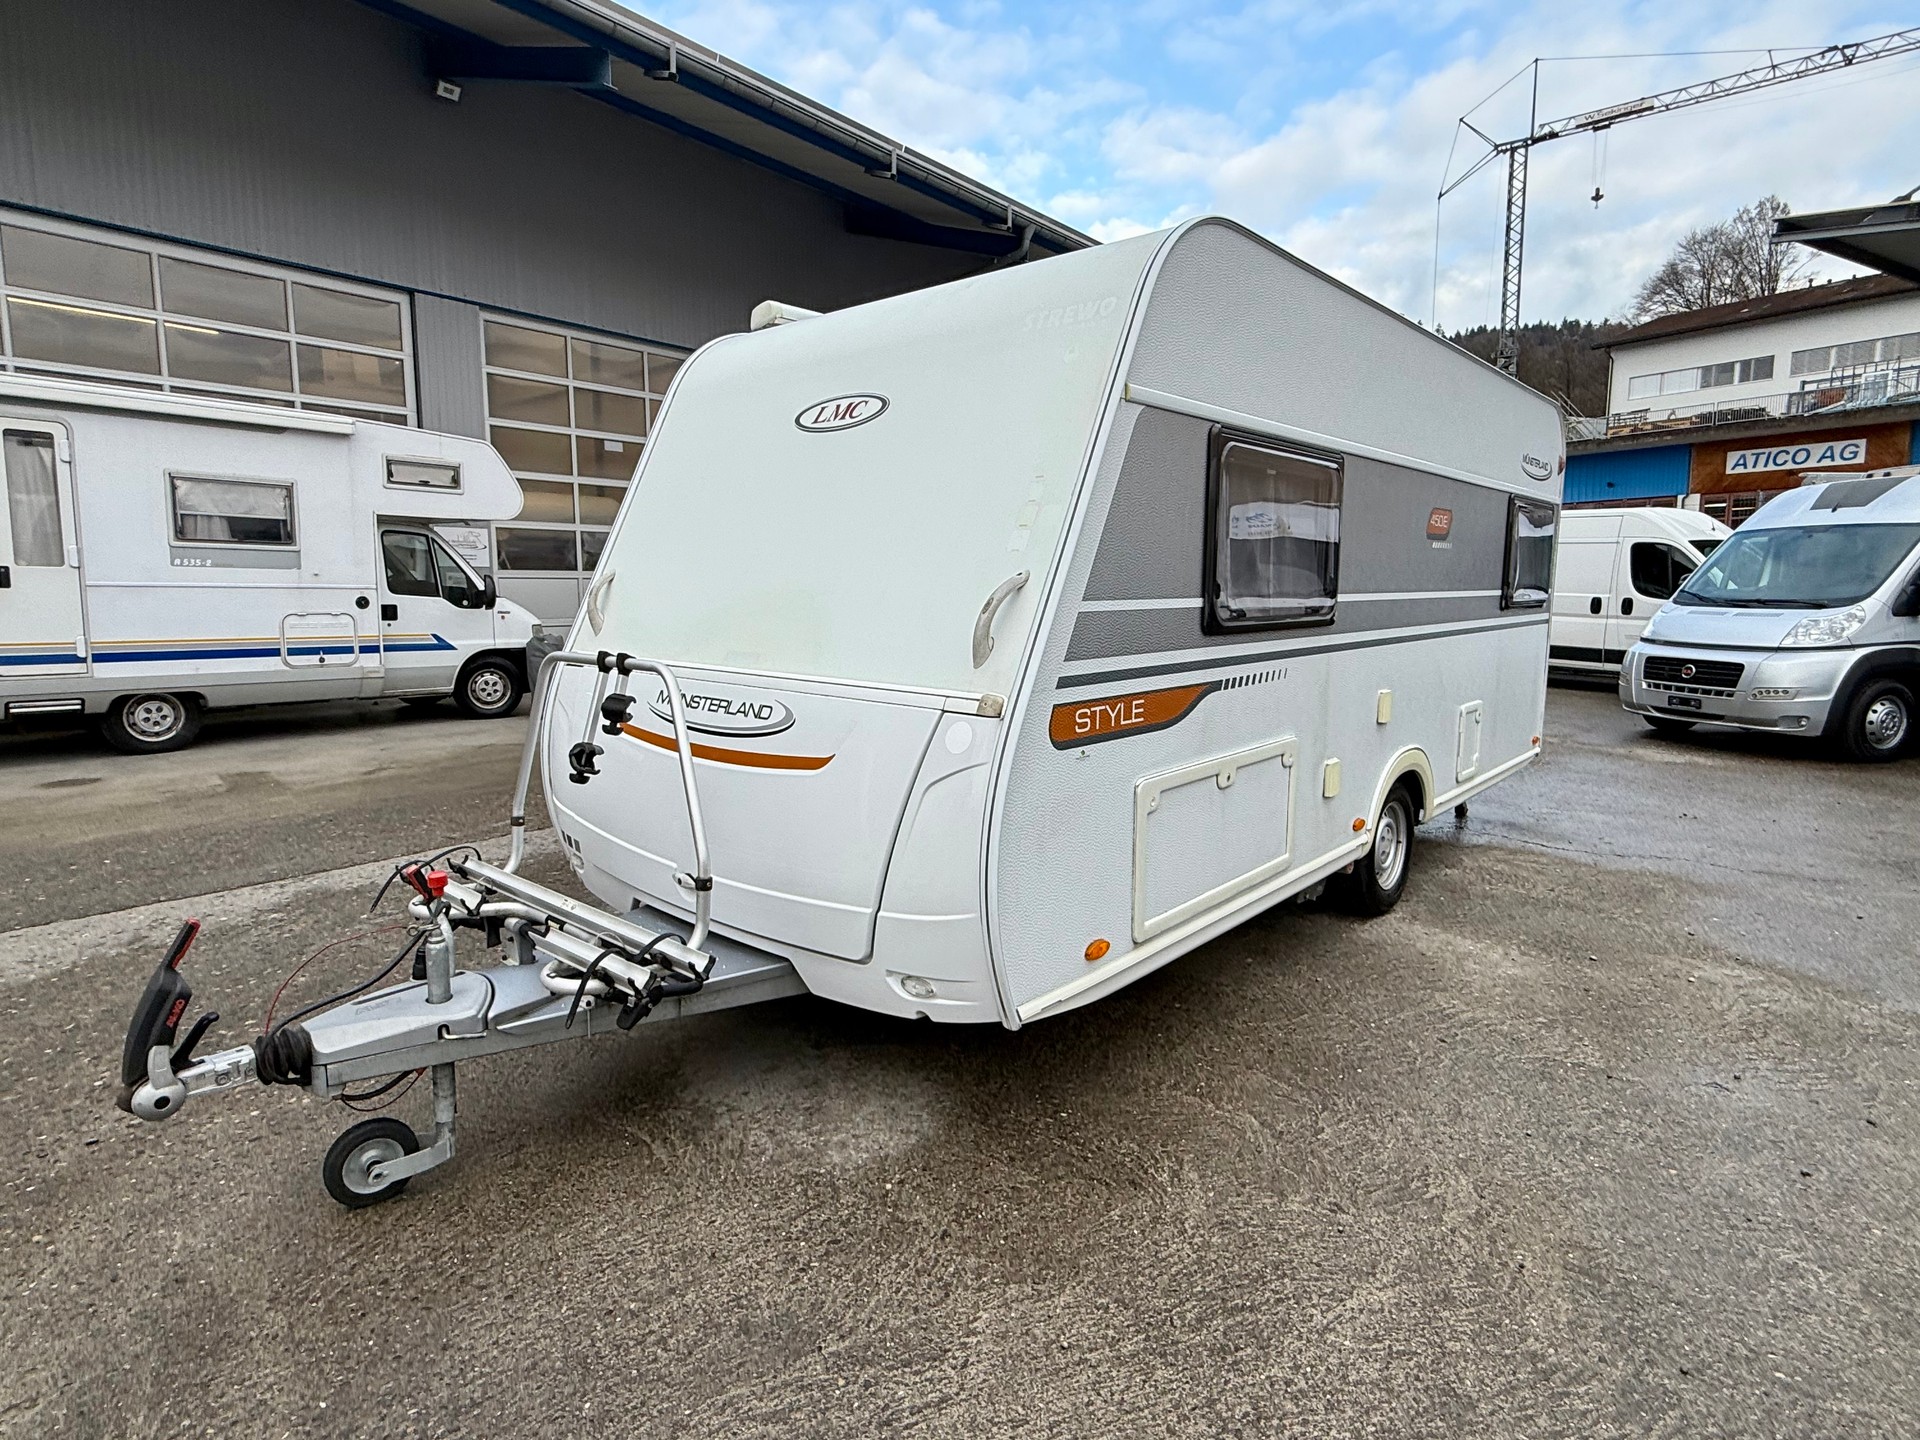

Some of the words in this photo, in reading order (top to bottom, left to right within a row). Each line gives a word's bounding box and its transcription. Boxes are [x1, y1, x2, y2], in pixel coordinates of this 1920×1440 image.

[811, 399, 869, 425] LMC
[1730, 447, 1811, 471] ATICO
[1816, 443, 1860, 464] AG
[182, 558, 212, 567] 535-2
[656, 689, 773, 721] MNSTERLAND
[1075, 699, 1145, 733] STYLE
